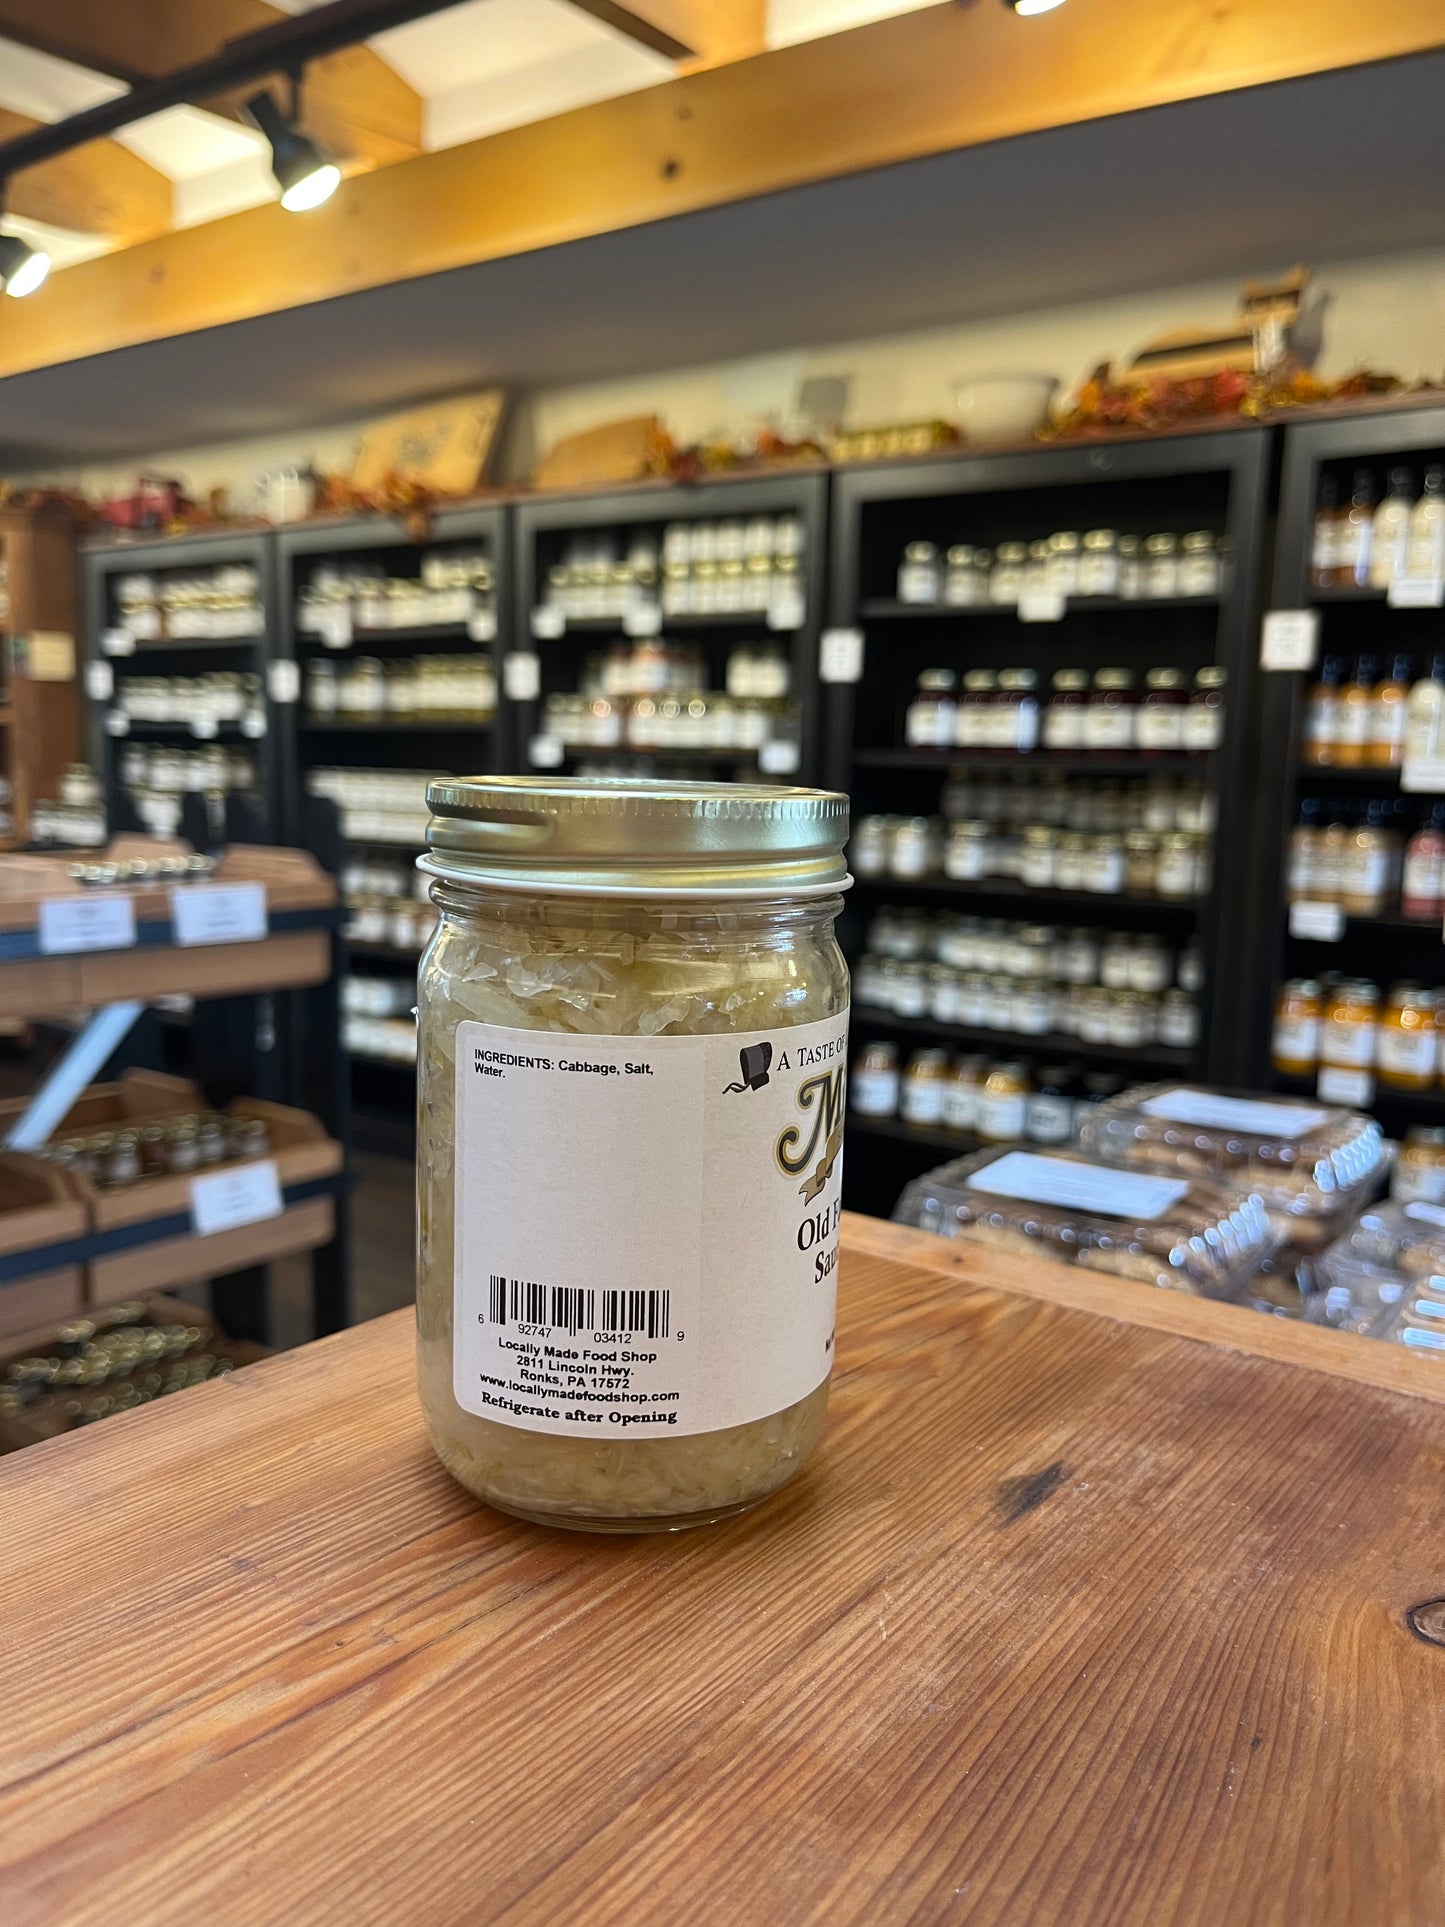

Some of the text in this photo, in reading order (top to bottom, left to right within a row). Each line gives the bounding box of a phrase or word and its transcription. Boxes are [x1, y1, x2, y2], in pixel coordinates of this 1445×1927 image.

[474, 1048, 654, 1076] INGREDIENTS: Cabbage, Salt,
[474, 1062, 506, 1078] Water.
[777, 1051, 791, 1071] A
[776, 1063, 847, 1176] M
[797, 1206, 830, 1251] Old
[478, 1313, 685, 1344] 6 92747 03412 9
[499, 1337, 657, 1363] Locally Made Food Shop
[516, 1355, 634, 1377] 2811 Lincoln Hwy.
[520, 1369, 630, 1389] Ronks, PA 17572
[479, 1373, 680, 1404] www.locallymadefoodshop.com
[481, 1391, 678, 1426] Refrigerate after Opening
